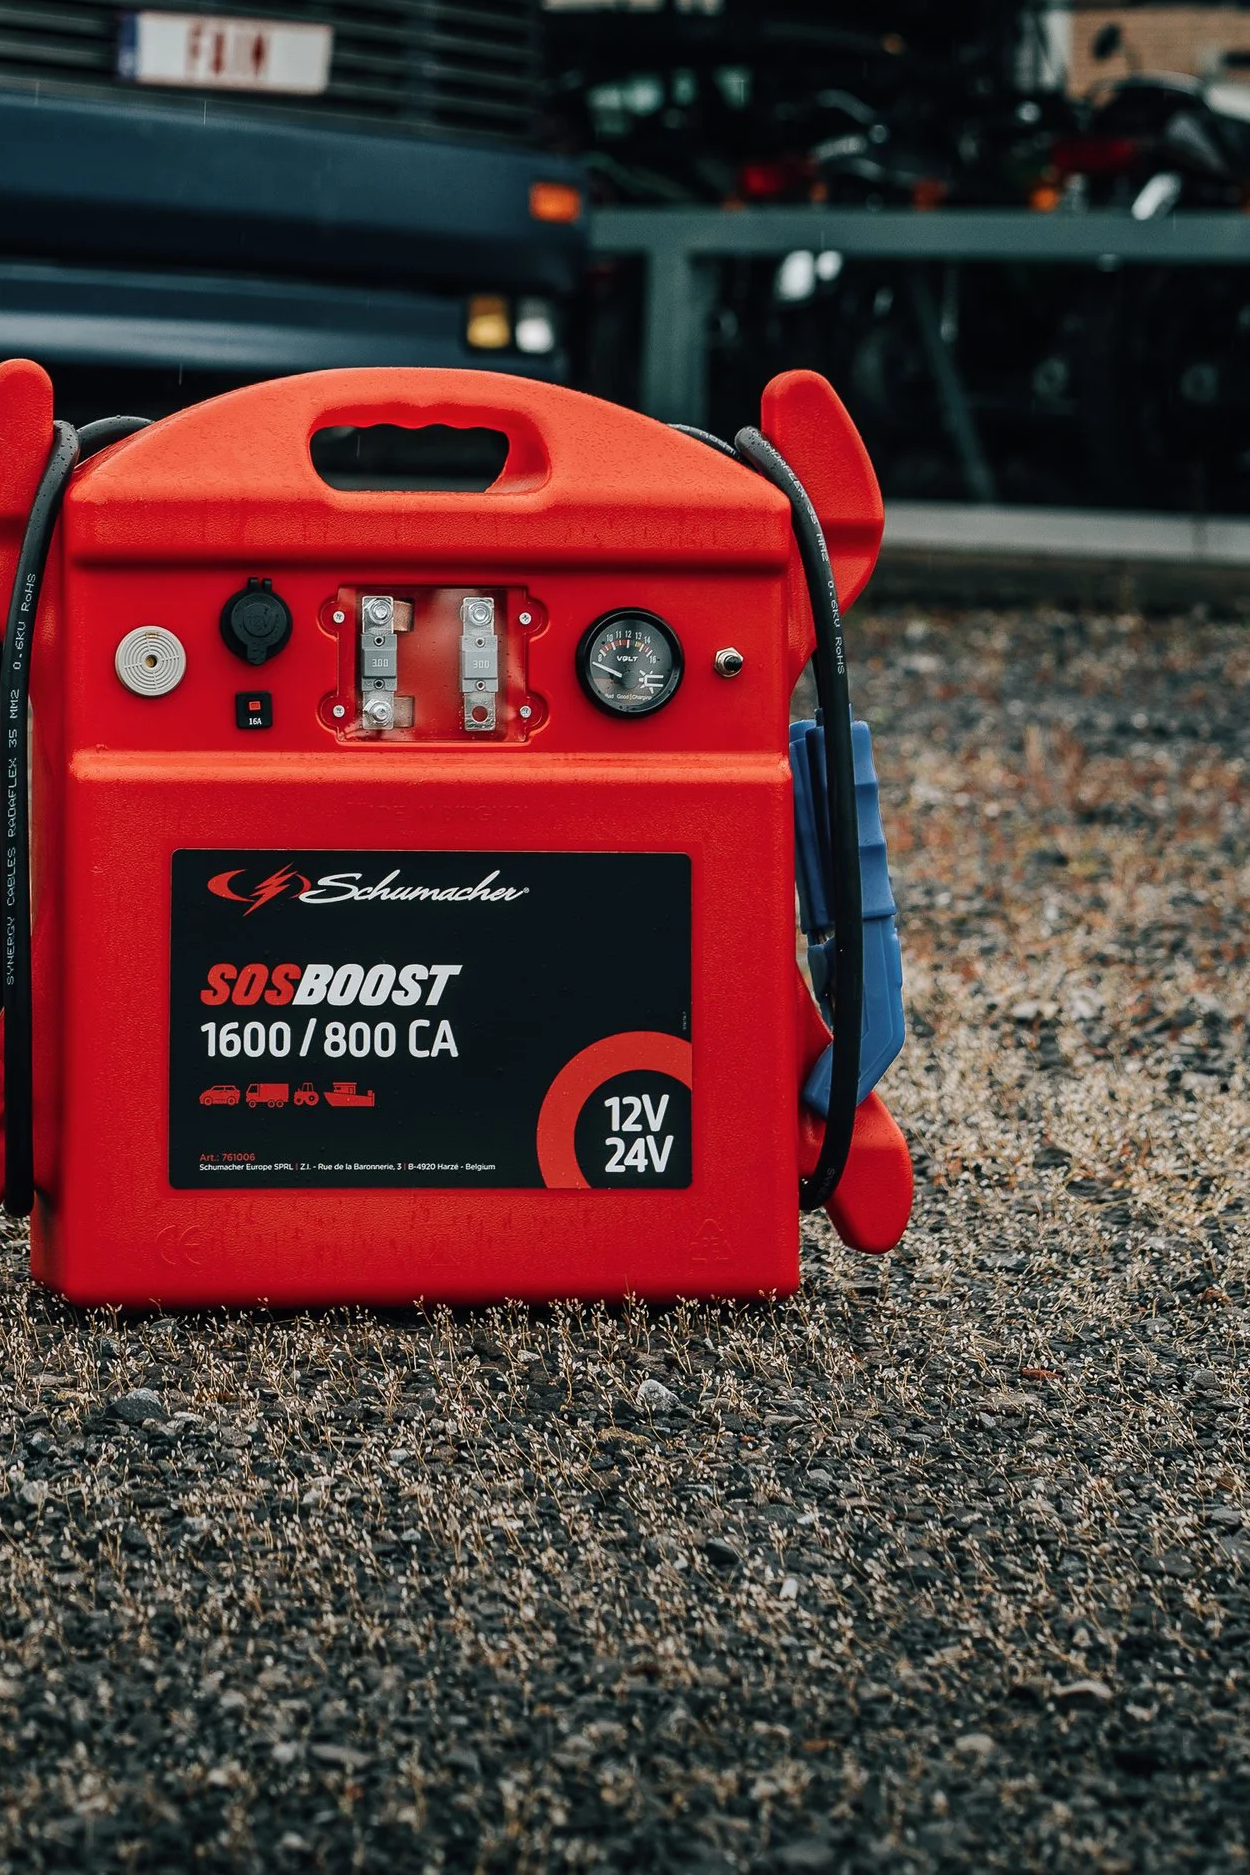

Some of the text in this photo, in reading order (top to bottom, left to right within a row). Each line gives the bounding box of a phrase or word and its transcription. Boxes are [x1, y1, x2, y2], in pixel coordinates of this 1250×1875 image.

[21, 572, 37, 613] RoHS
[615, 630, 622, 639] 11
[625, 630, 632, 639] 12
[635, 631, 642, 640] 13
[372, 658, 389, 668] 300
[472, 659, 490, 669] 300
[832, 635, 846, 675] RoHS
[9, 688, 20, 719] MM2
[248, 717, 262, 726] 16A
[8, 728, 18, 749] 35
[7, 757, 18, 838] RADAFLEX
[6, 846, 16, 907] CABLES
[6, 915, 16, 986] SYNERGY
[200, 963, 463, 1006] SOSBOOST
[200, 1021, 292, 1058] 1600
[323, 1021, 397, 1058] 800
[409, 1019, 459, 1058] CA
[604, 1094, 670, 1132] 12V
[199, 1163, 245, 1171] Schumacher
[246, 1163, 273, 1172] Europe
[273, 1163, 294, 1171] SPRL
[317, 1163, 333, 1171] Rue
[334, 1163, 345, 1171] de
[345, 1163, 352, 1171] la
[354, 1163, 396, 1172] Baronnerie,
[396, 1163, 403, 1171] 3
[408, 1163, 437, 1171] B-4920
[437, 1162, 459, 1171] Harzé
[465, 1163, 496, 1172] Belgium
[222, 1153, 256, 1162] 761006
[605, 1135, 674, 1173] 24V
